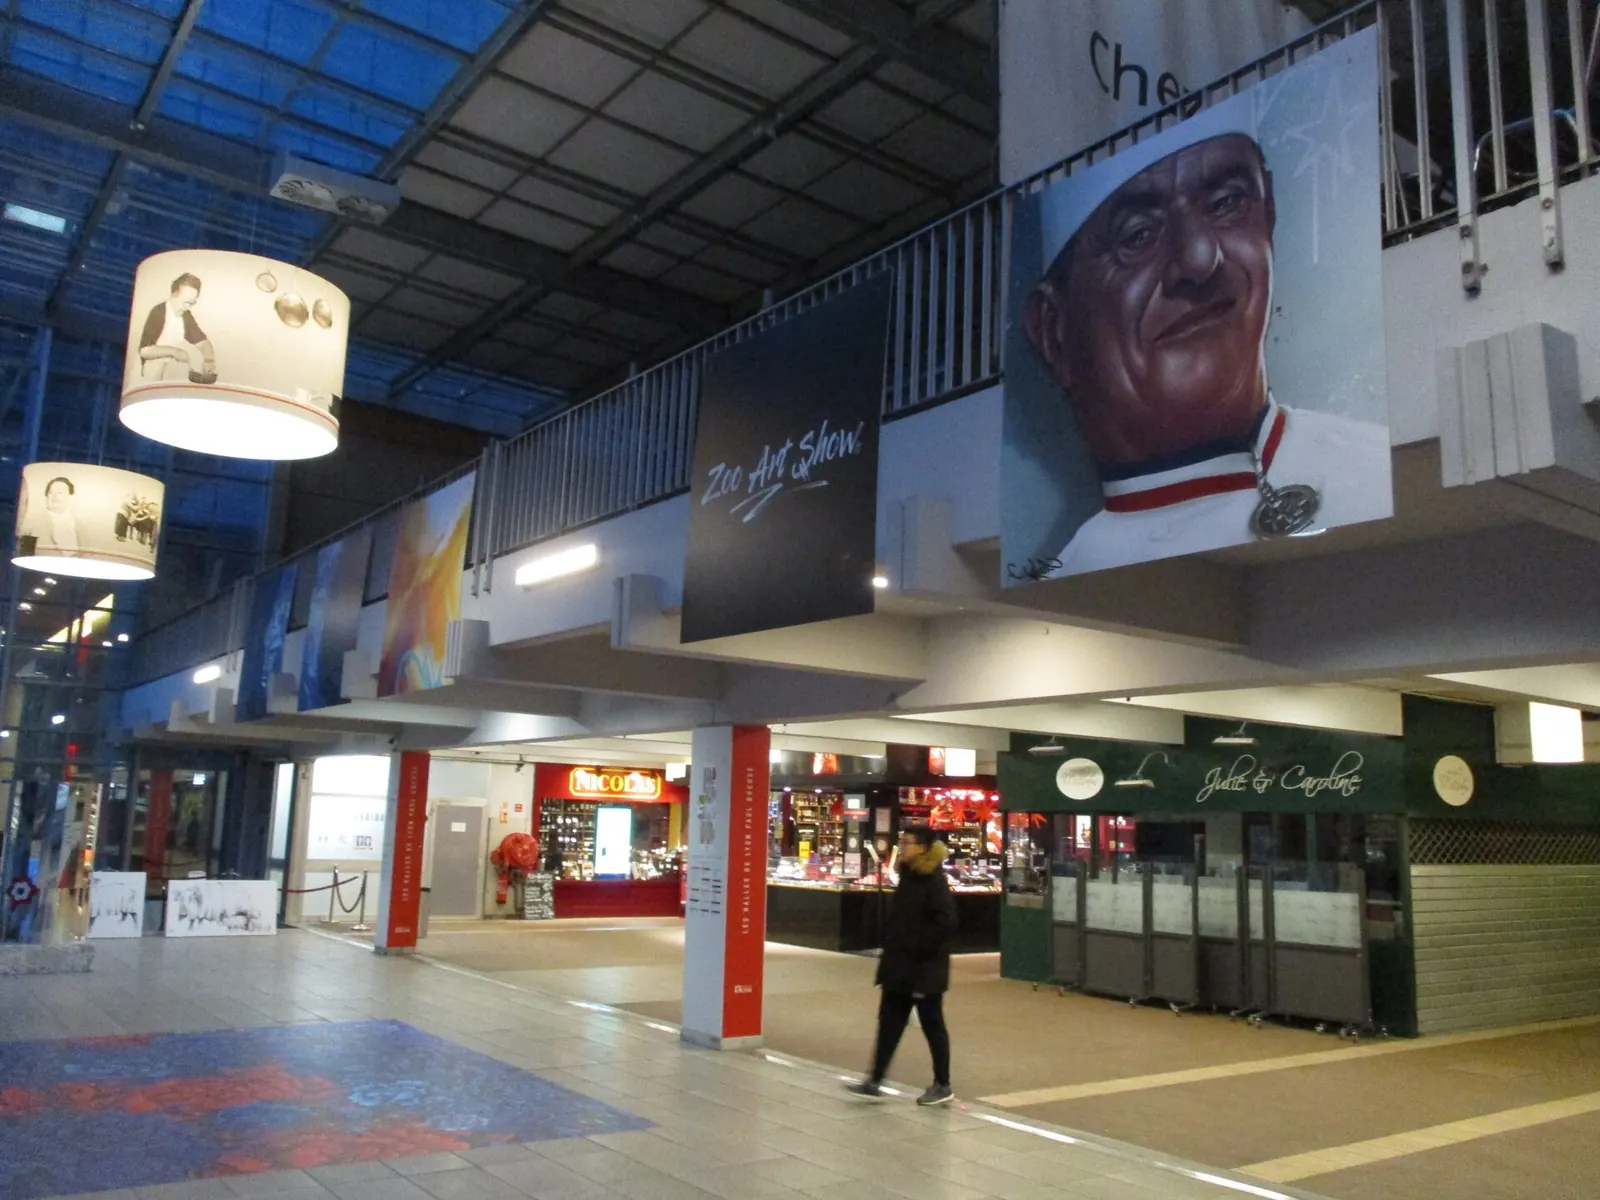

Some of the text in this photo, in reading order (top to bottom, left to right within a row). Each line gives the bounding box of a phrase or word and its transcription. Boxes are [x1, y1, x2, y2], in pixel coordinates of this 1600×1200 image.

[702, 419, 864, 506] Zoo Art Show
[575, 770, 656, 793] NICOLAS
[1196, 750, 1364, 802] Julie & Caroline
[745, 806, 753, 829] PAUL
[744, 833, 752, 856] LYON
[743, 861, 752, 873] DE
[743, 877, 751, 913] HALLES
